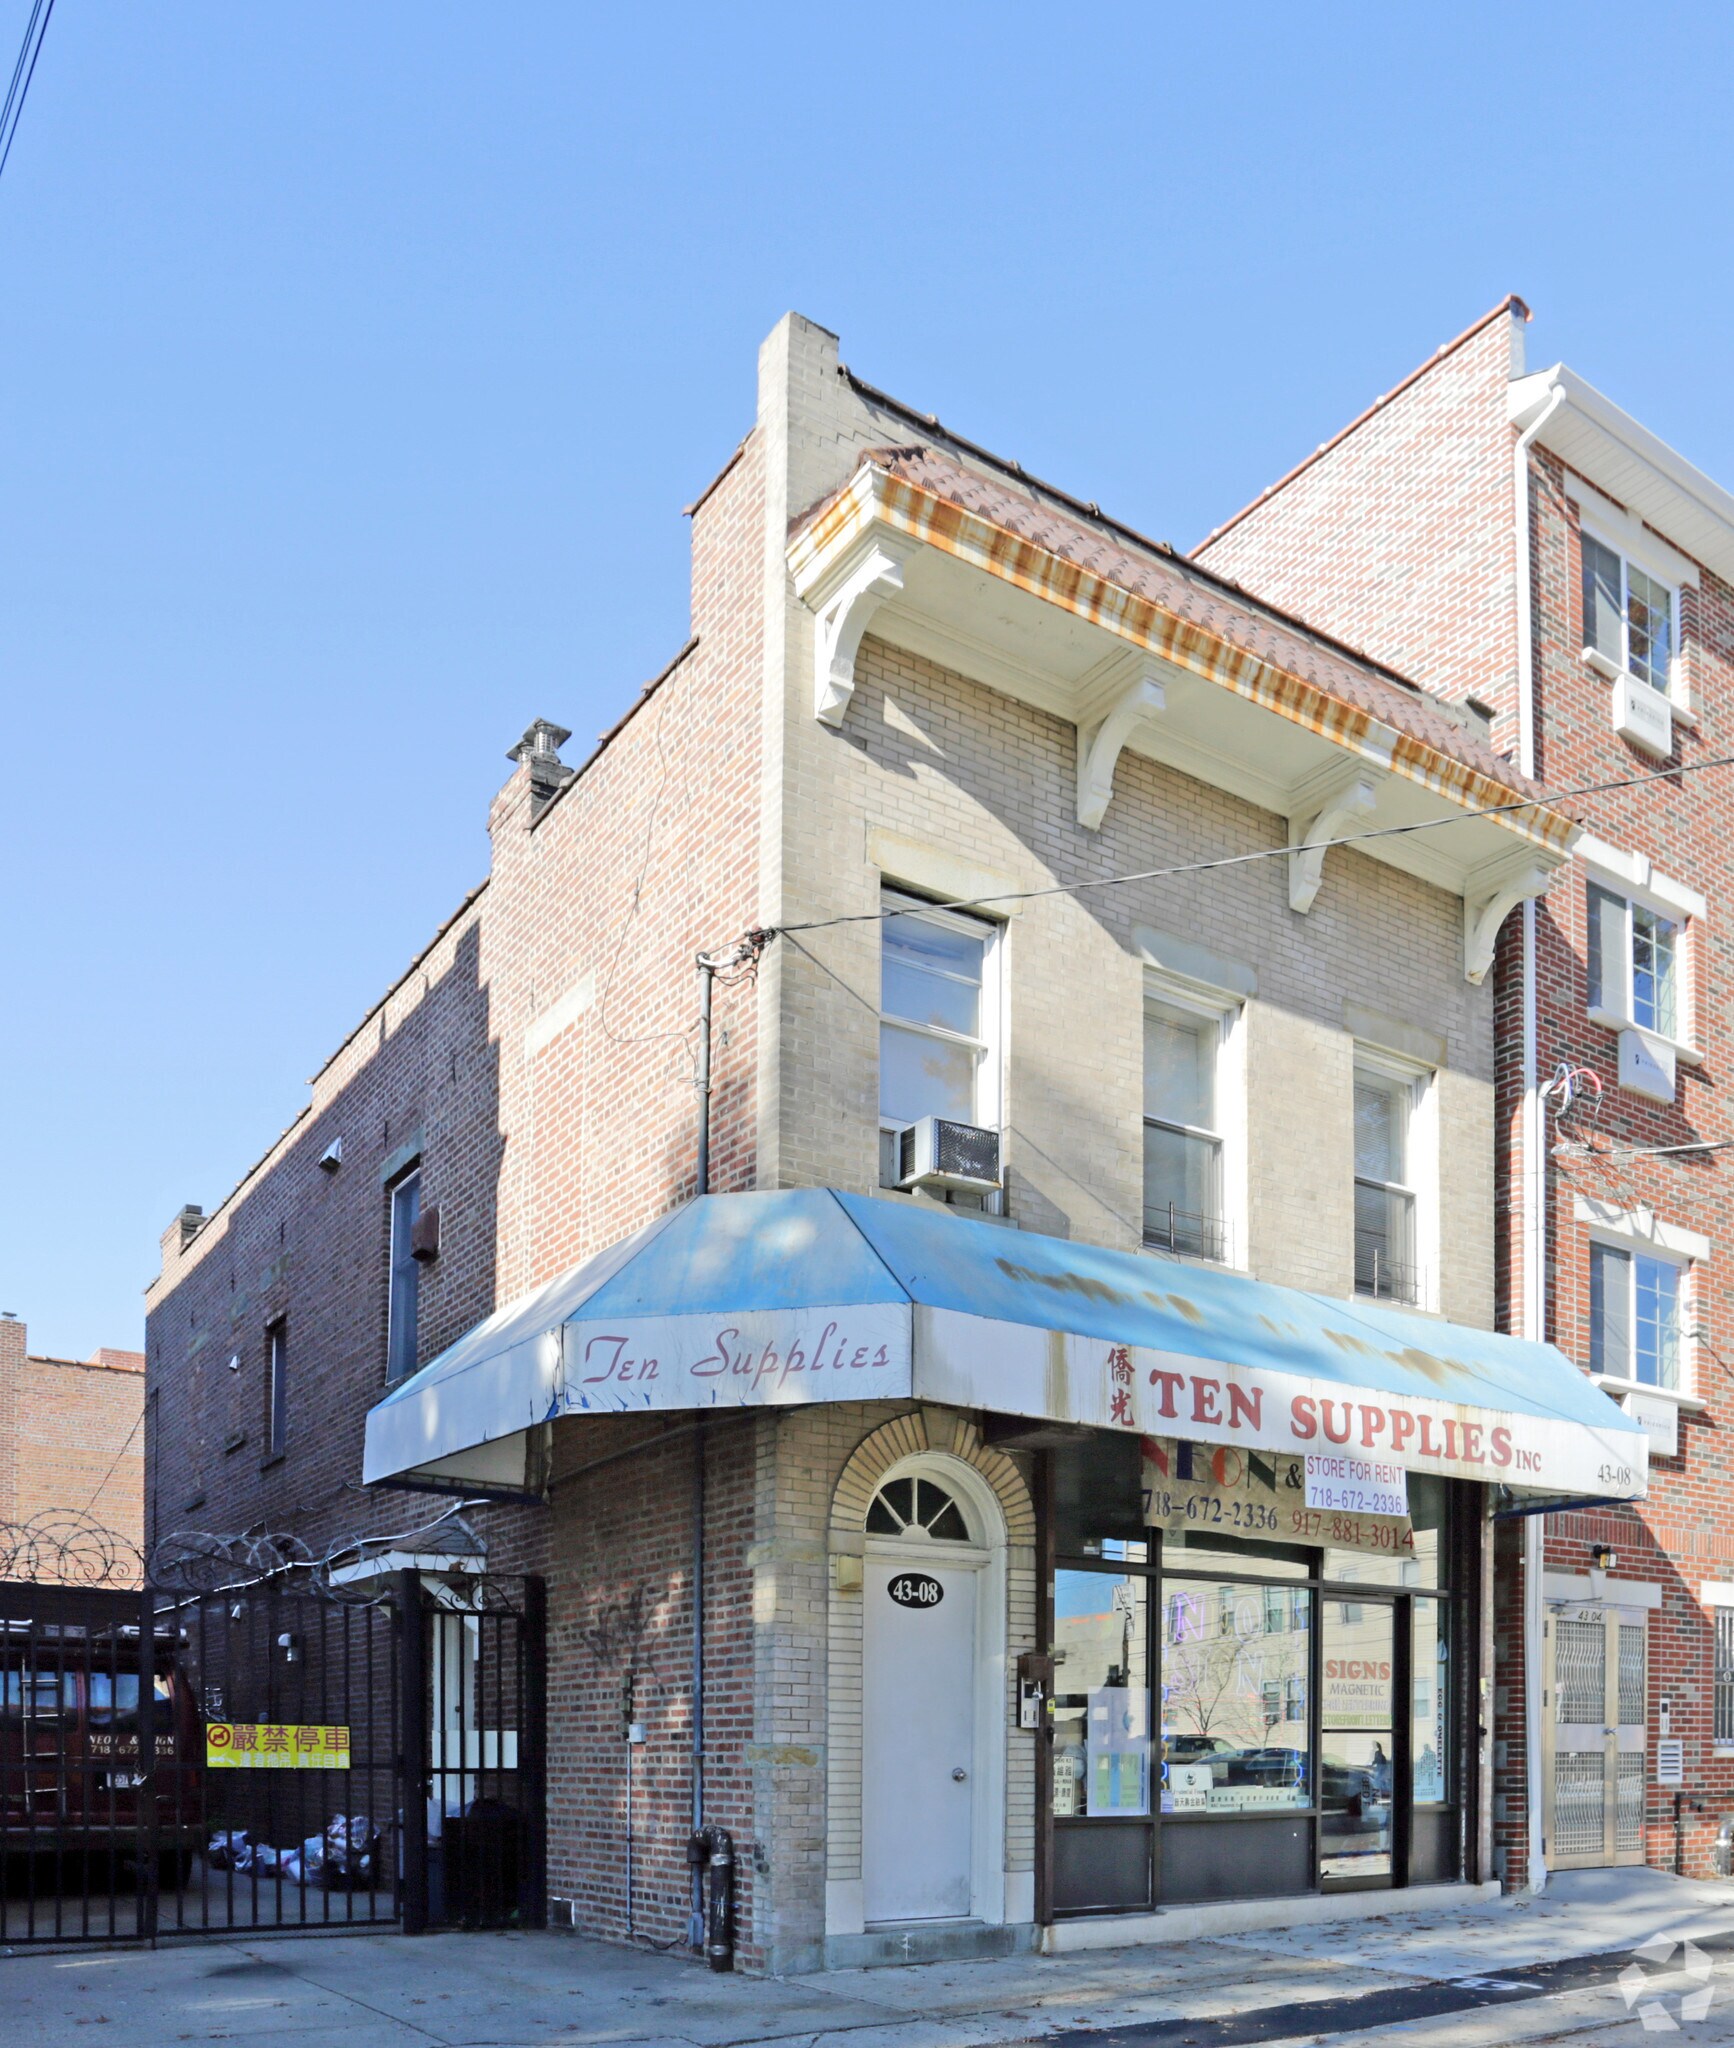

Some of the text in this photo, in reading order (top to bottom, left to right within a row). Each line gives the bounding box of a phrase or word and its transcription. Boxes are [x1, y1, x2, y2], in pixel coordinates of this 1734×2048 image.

[582, 1321, 891, 1391] Ten Supplies
[1107, 1347, 1136, 1427] 僑光
[1149, 1368, 1542, 1473] TEN SUPPLIES INC
[1139, 1433, 1302, 1493] NEON &
[1307, 1455, 1403, 1485] STORE FOR RENT
[1597, 1463, 1632, 1487] 43-08
[1311, 1486, 1402, 1514] 718-672-2336
[1141, 1489, 1415, 1550] 718-672-2336 917-881-3014
[893, 1579, 938, 1603] 43-08
[1325, 1659, 1391, 1681] SIGNS
[1329, 1683, 1385, 1696] MAGNETIC
[129, 1735, 139, 1745] &
[231, 1724, 350, 1753] 嚴禁停車
